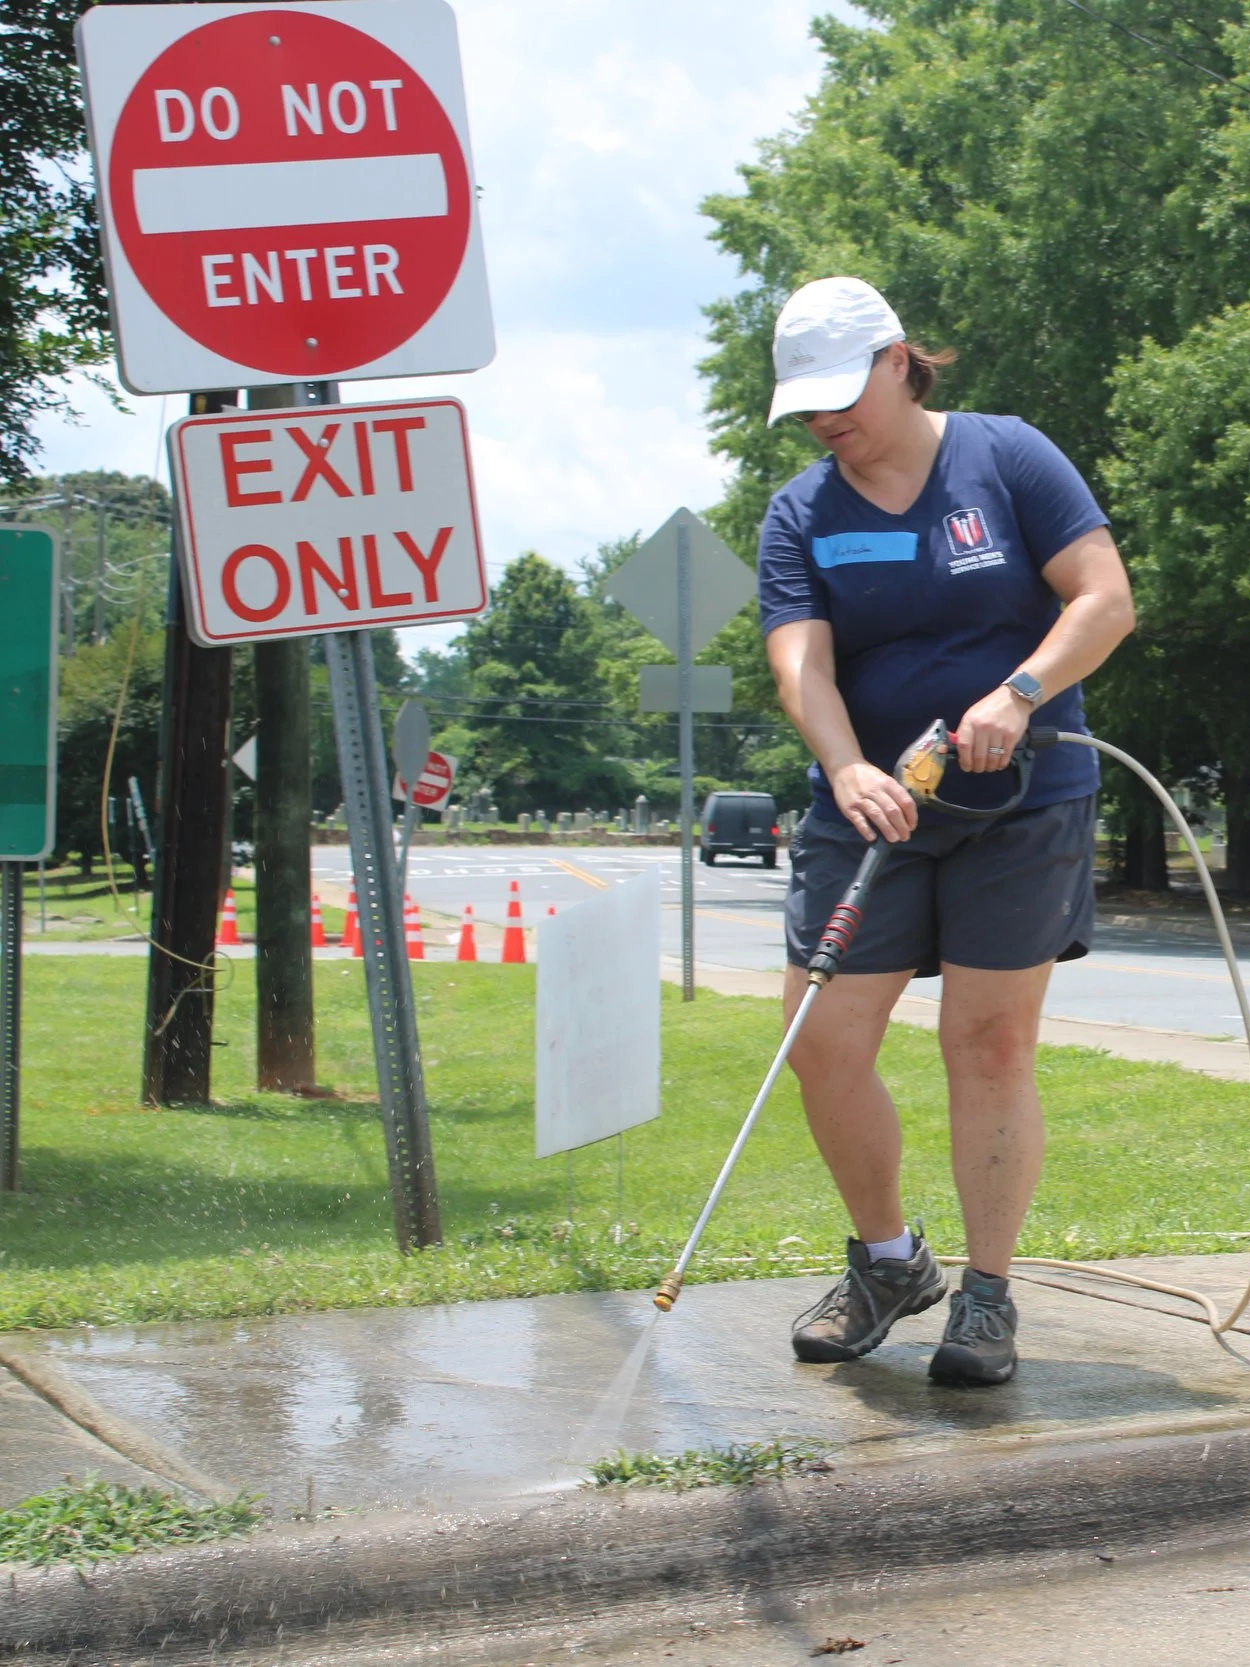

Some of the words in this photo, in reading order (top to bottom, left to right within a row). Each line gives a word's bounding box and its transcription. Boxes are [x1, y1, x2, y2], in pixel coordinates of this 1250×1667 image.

[155, 87, 240, 142] DO
[282, 79, 403, 137] NOT
[201, 244, 403, 308] ENTER
[218, 416, 426, 508] EXIT
[221, 526, 454, 622] ONLY
